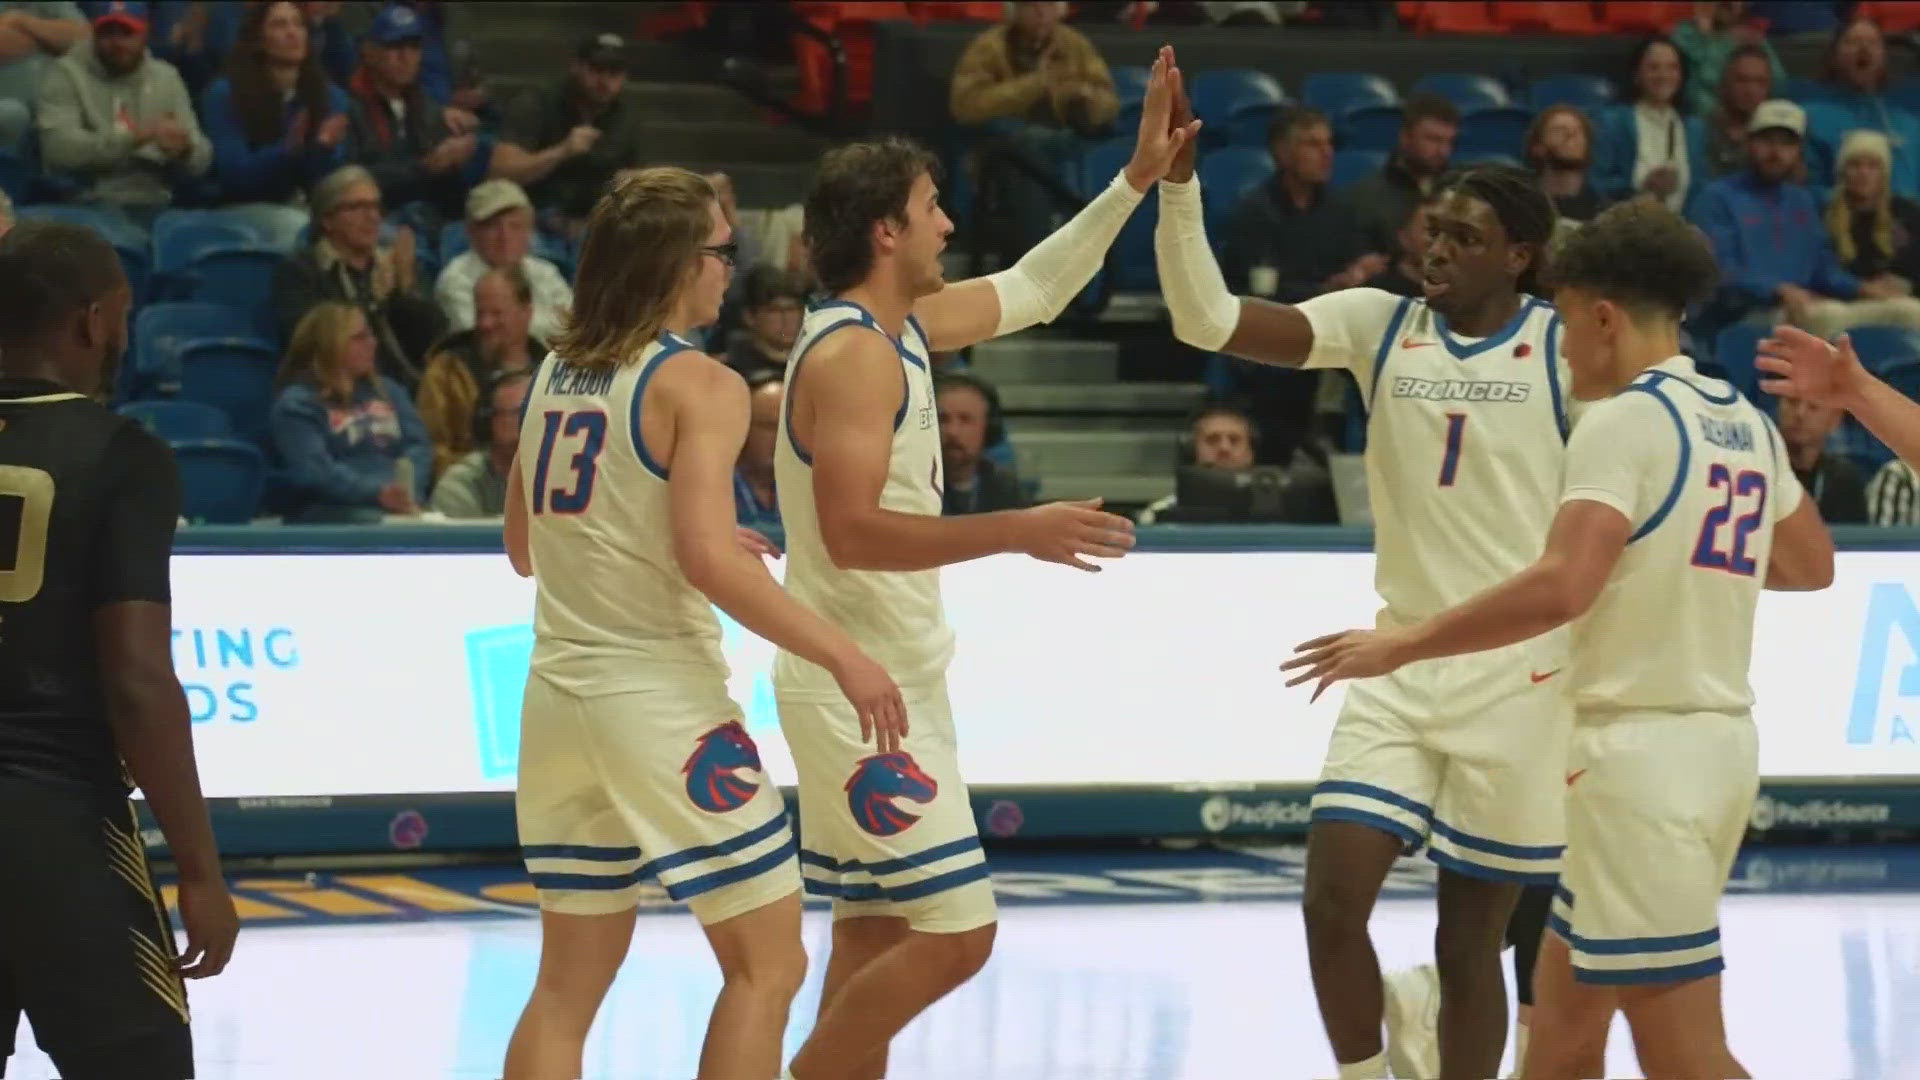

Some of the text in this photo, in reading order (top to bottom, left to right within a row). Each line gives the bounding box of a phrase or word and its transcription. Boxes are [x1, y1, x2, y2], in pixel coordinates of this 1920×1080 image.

[1391, 376, 1532, 403] BRONCOS
[533, 409, 608, 516] 13
[1438, 412, 1467, 488] 1
[1690, 462, 1767, 577] 22
